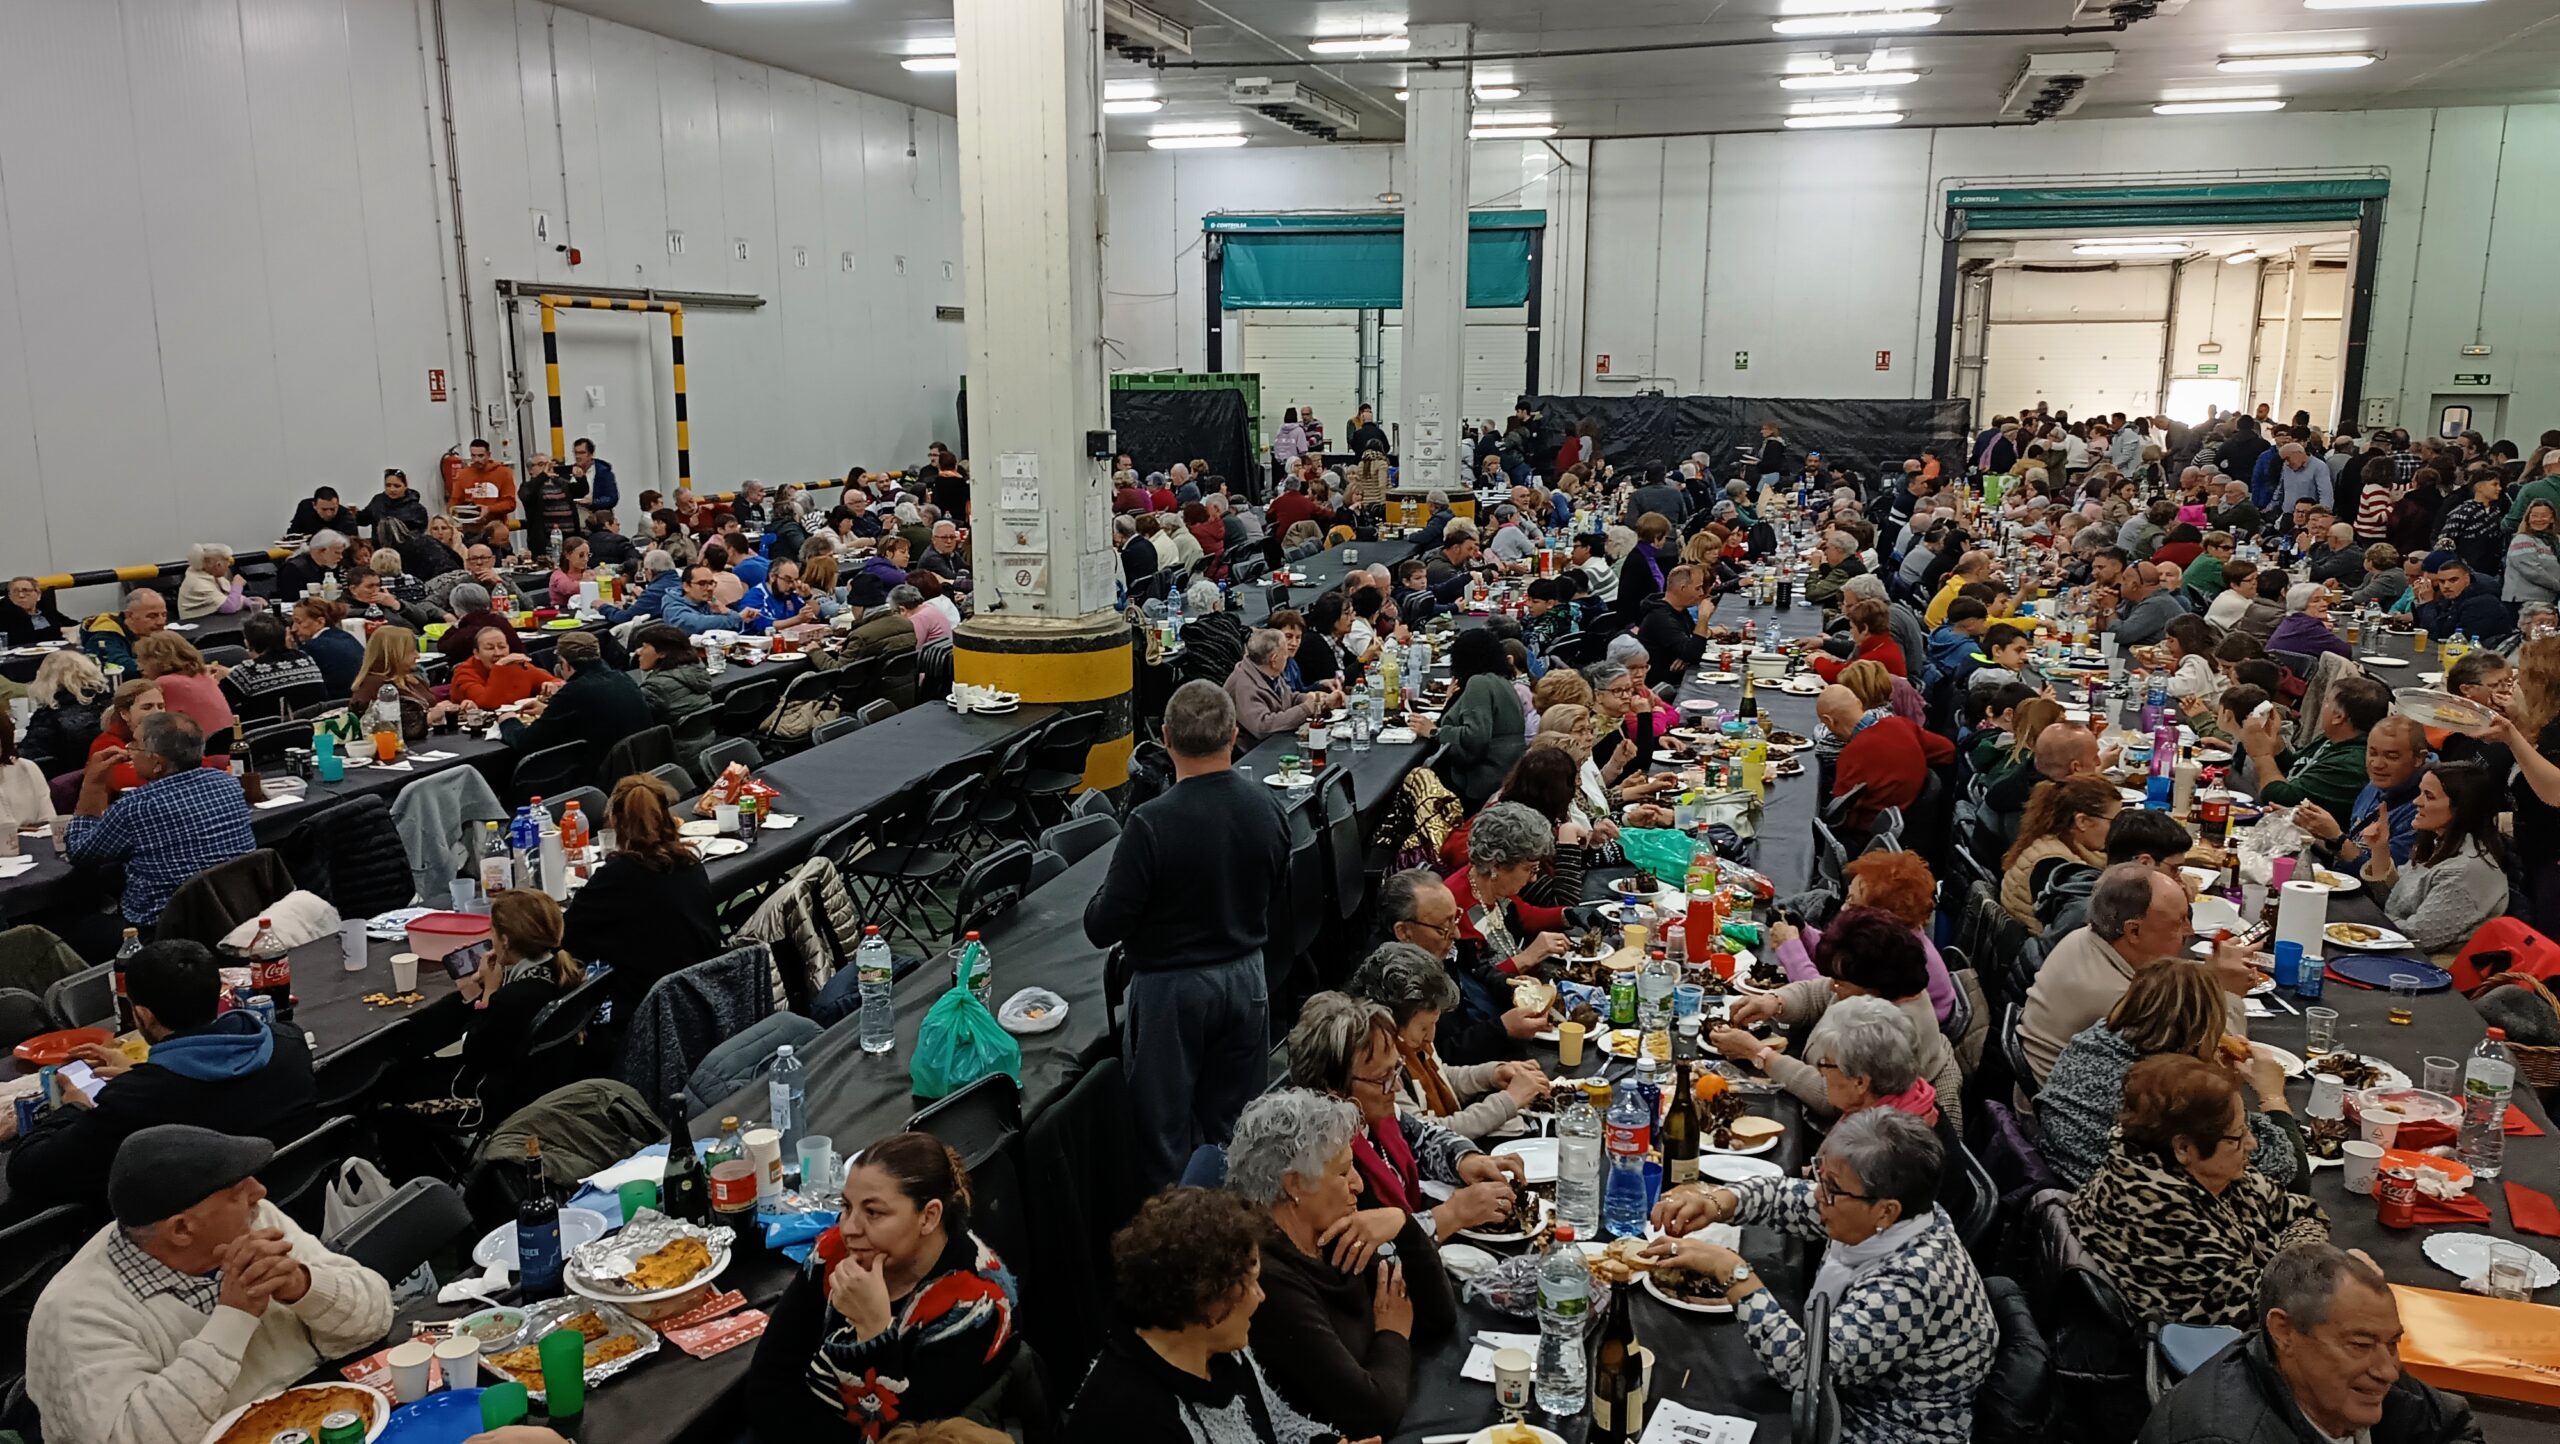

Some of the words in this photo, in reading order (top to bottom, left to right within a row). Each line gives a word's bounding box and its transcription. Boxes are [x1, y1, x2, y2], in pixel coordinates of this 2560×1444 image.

[538, 215, 547, 242] 4
[672, 235, 682, 253] 11
[737, 243, 747, 260] 12
